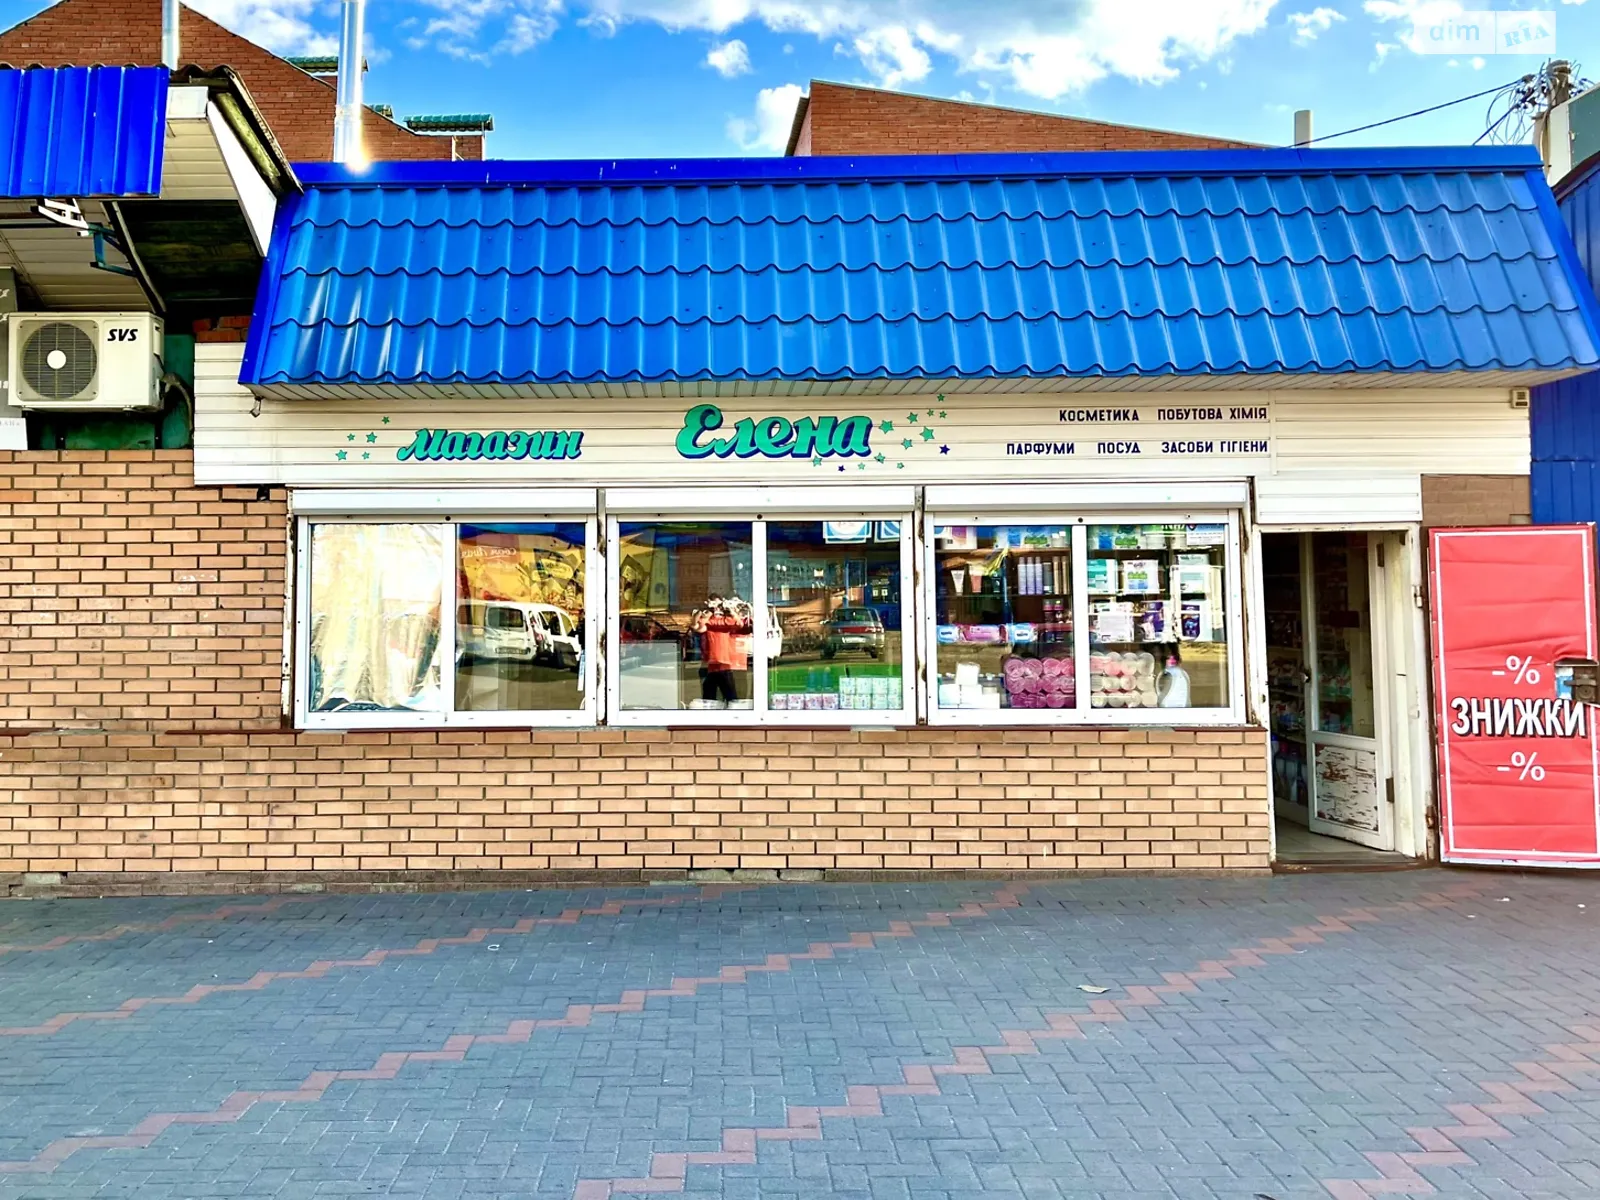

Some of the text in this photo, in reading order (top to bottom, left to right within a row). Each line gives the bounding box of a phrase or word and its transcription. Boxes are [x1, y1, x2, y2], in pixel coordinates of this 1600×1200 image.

[107, 328, 139, 342] SVS
[1059, 407, 1267, 422] КОСМЕТИКА ПОБУТОВА ХІМІЯ
[675, 403, 874, 459] Елена
[396, 428, 585, 461] Магазин
[1006, 442, 1075, 455] ПАРФУМИ
[1097, 442, 1141, 454] ПОСУД
[1161, 441, 1213, 453] ЗАСОБИ
[1450, 696, 1588, 739] ЗНИЖКИ
